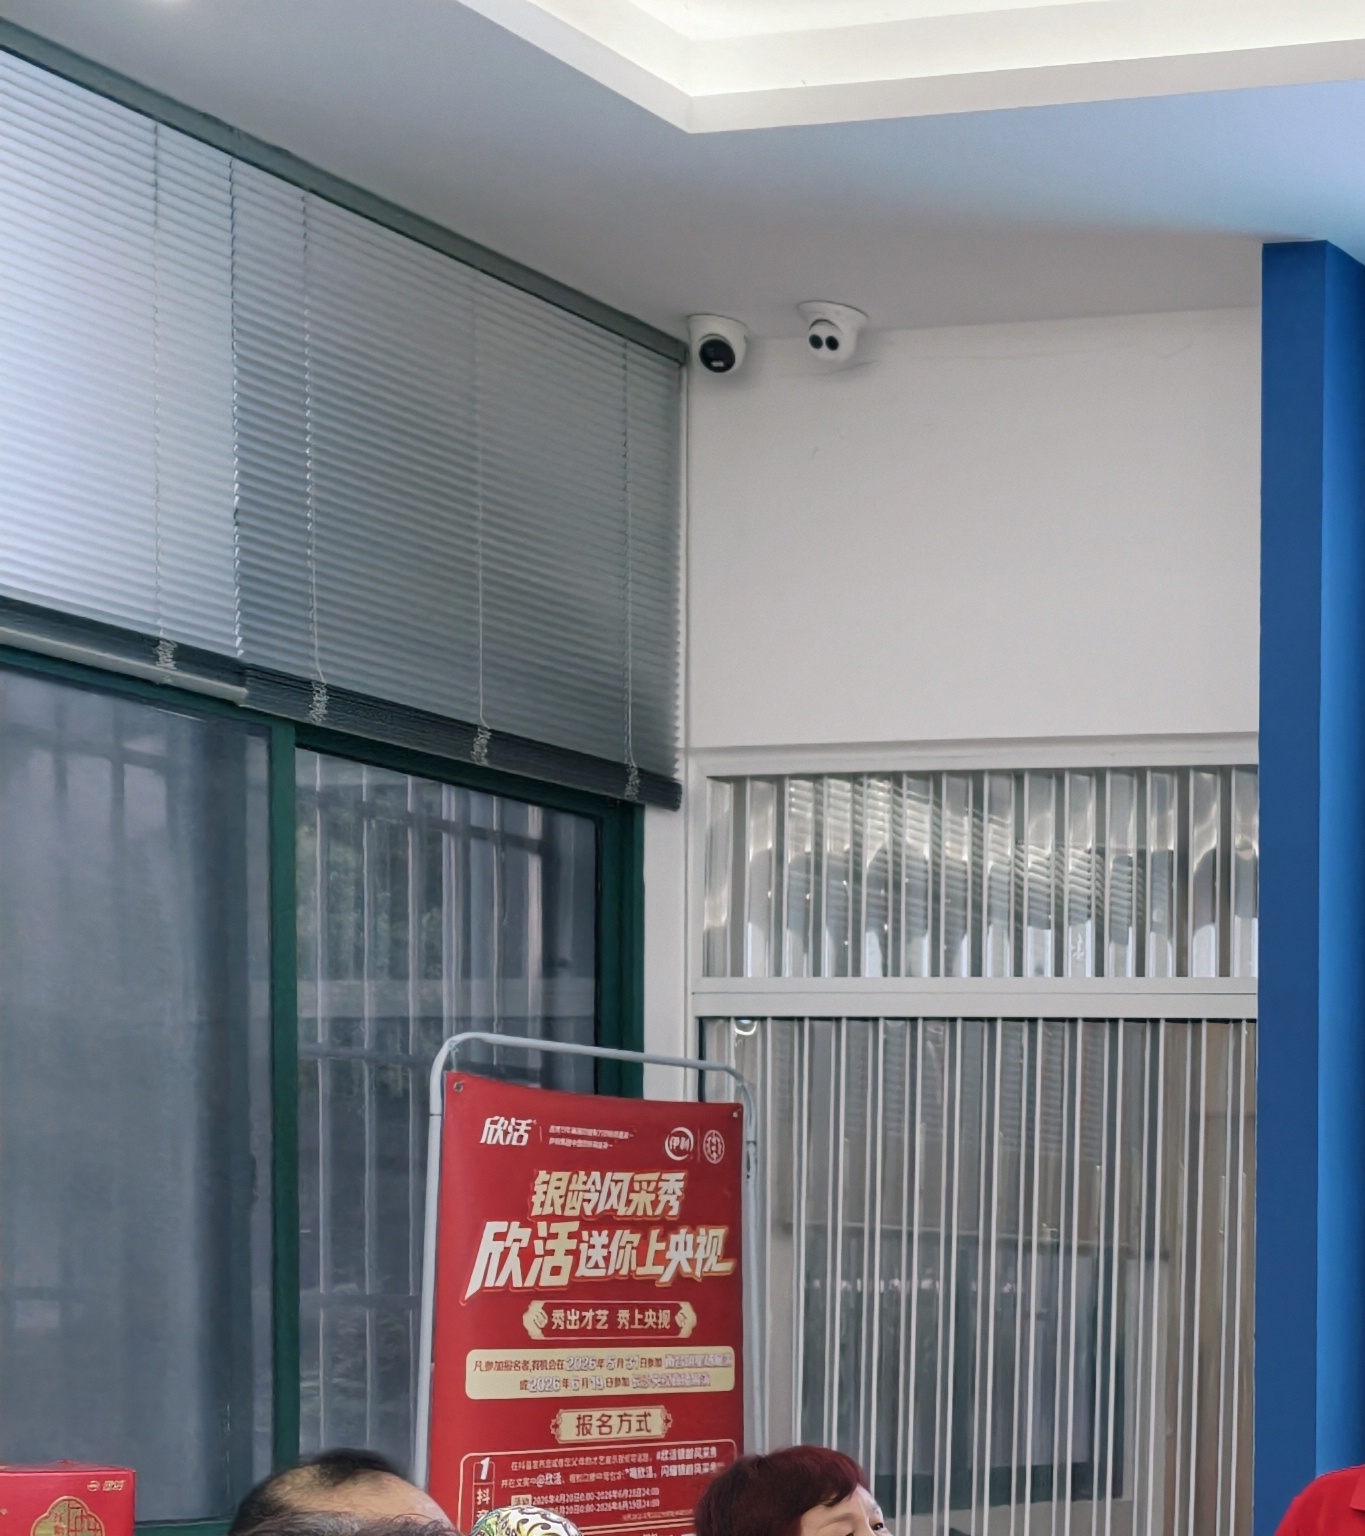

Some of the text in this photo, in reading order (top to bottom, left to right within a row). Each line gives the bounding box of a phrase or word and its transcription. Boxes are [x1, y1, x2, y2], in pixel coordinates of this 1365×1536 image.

[480, 1115, 533, 1147] 欣活
[531, 1170, 686, 1218] 银龄风采秀
[463, 1220, 735, 1302] 欣活送你上央视
[551, 1308, 671, 1330] 秀出才艺 秀上央视
[575, 1411, 654, 1437] 报名方式
